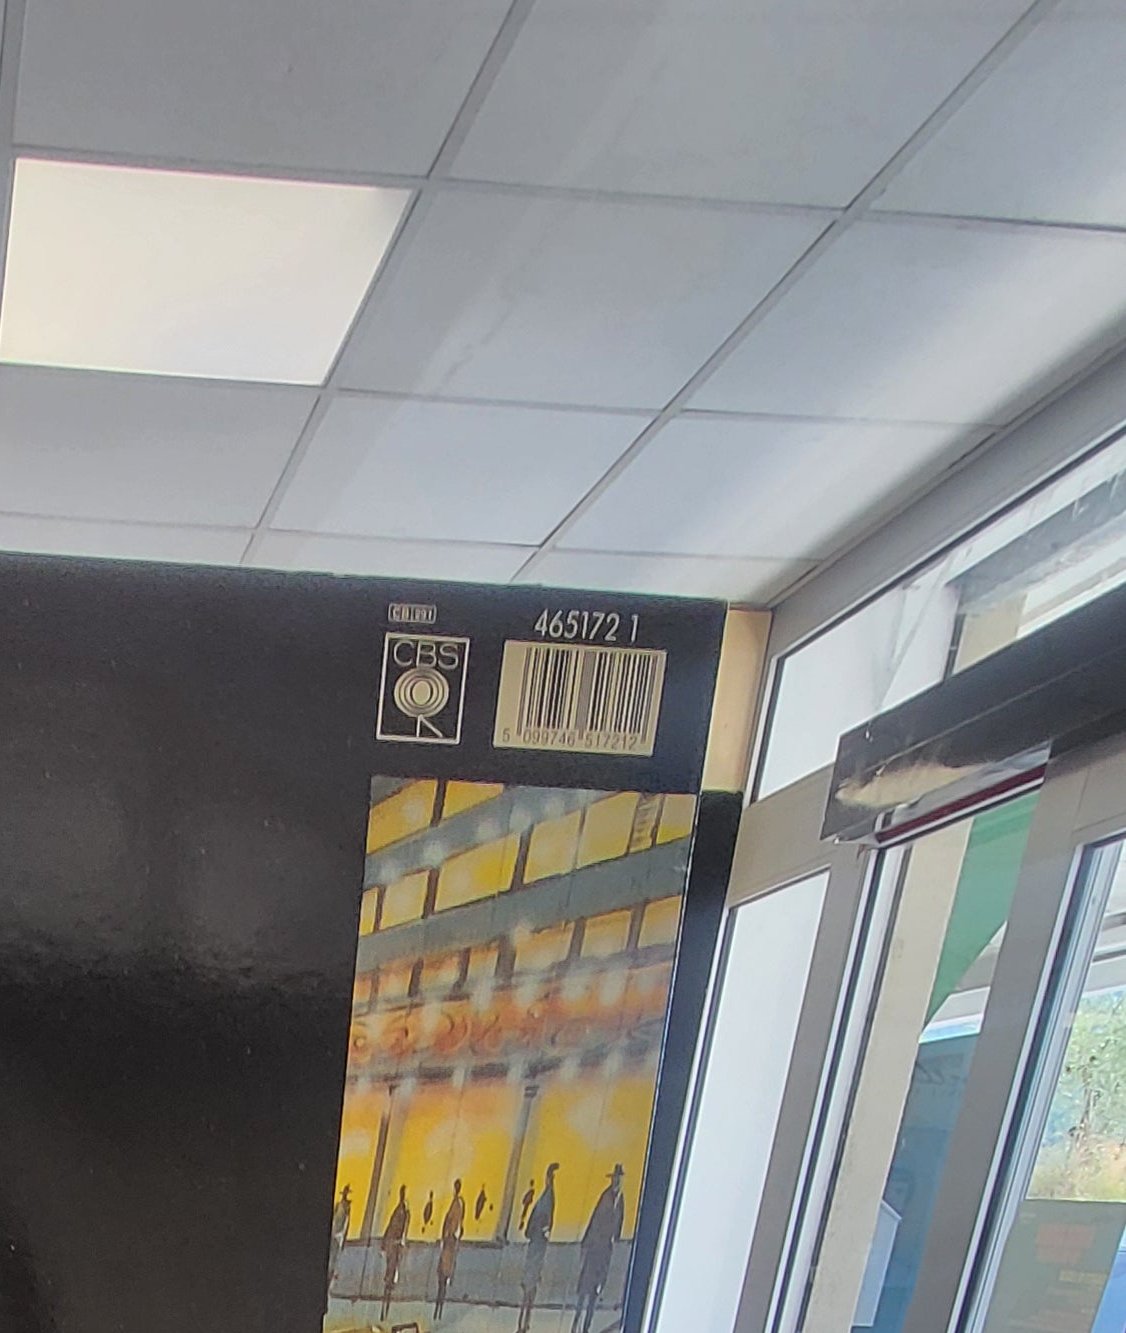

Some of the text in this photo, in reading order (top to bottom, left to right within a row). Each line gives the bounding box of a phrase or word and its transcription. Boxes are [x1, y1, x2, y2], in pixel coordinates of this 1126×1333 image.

[534, 608, 639, 643] 465172 1
[393, 640, 459, 670] CBS
